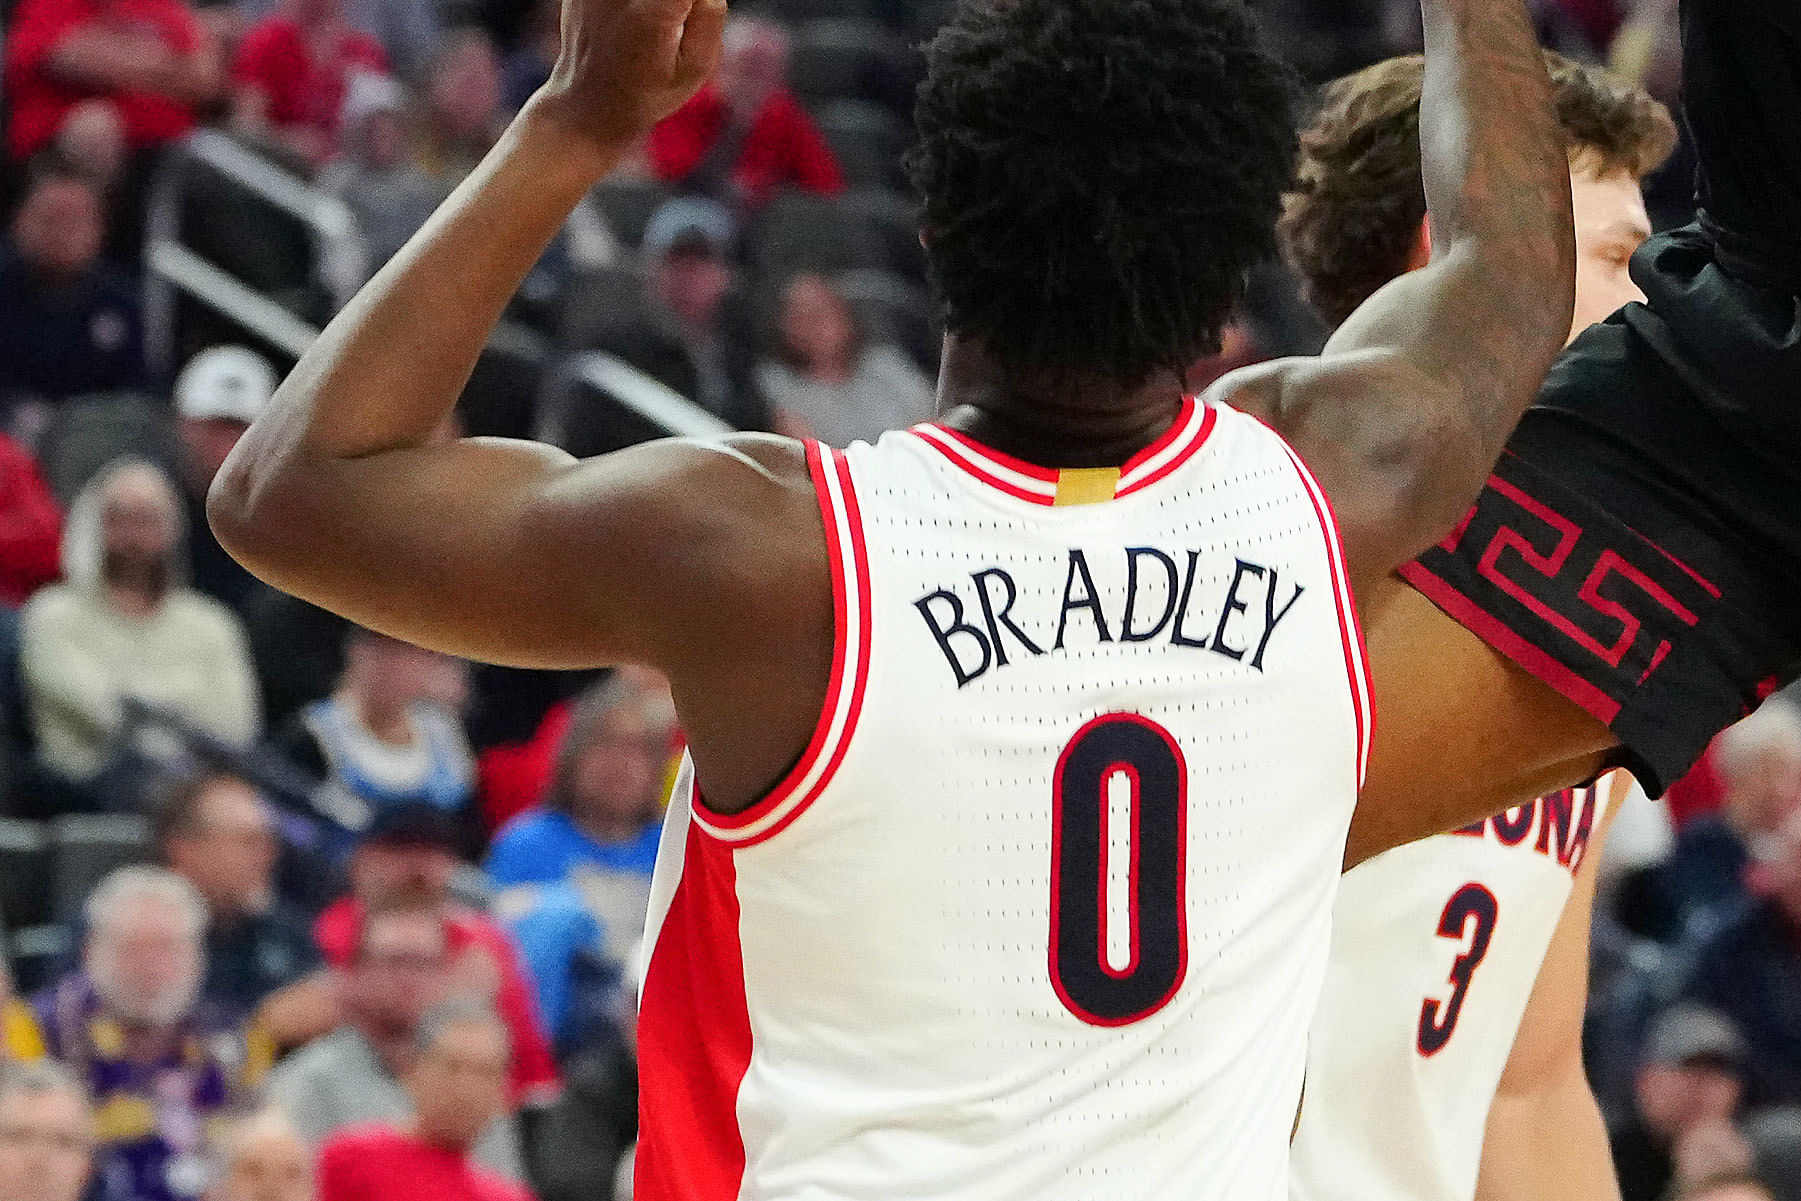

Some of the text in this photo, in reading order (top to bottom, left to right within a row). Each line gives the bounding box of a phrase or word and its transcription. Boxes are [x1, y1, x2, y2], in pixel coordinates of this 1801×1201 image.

[914, 547, 1305, 689] BRADLEY
[1047, 711, 1188, 1029] 0
[1417, 882, 1499, 1058] 3
